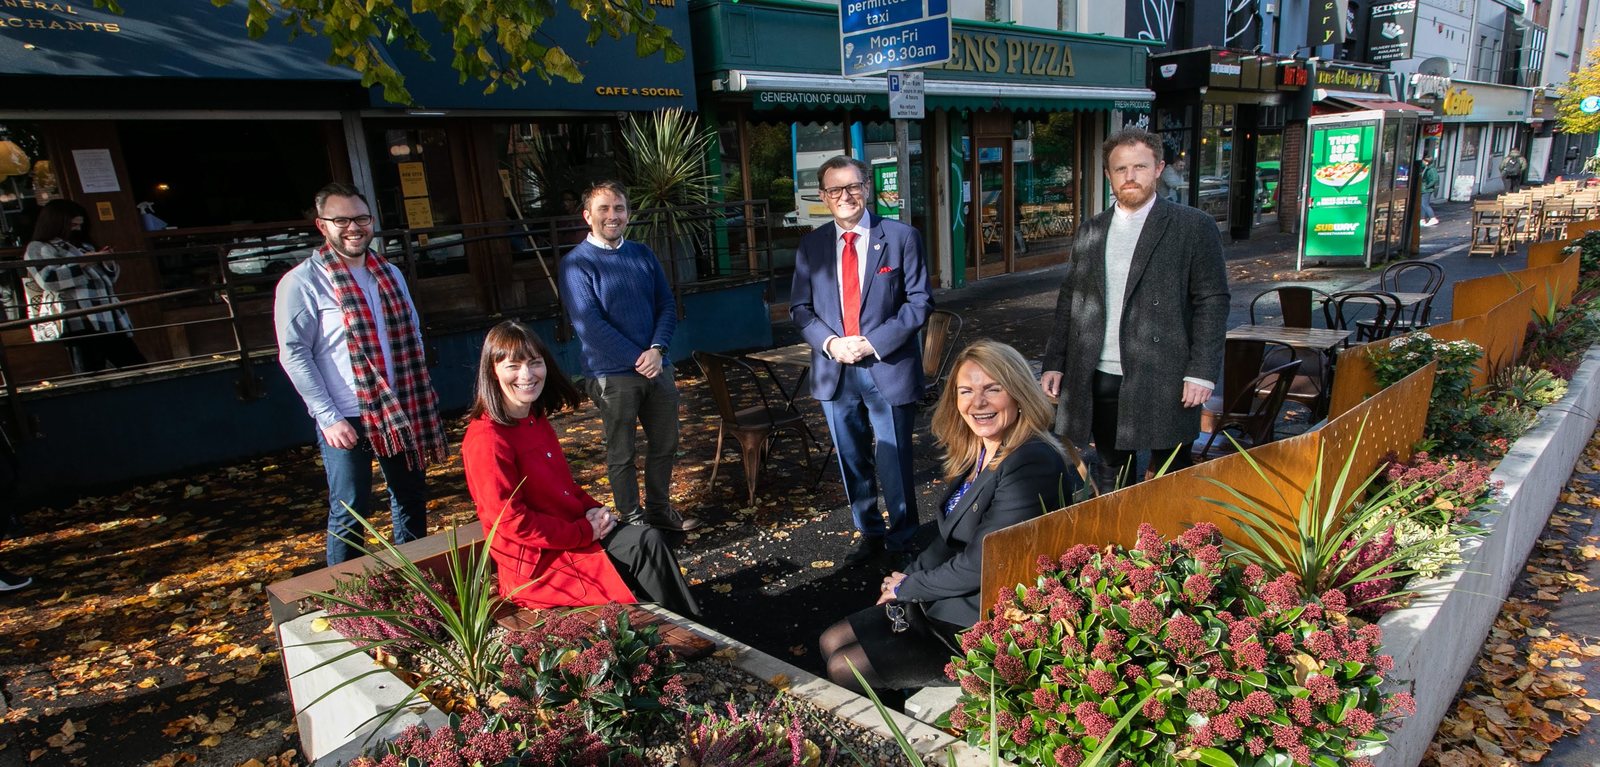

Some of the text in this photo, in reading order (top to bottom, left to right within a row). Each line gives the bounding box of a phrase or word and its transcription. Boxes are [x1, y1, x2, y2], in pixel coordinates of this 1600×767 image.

[0, 0, 78, 14] NERAL
[1372, 1, 1416, 15] KINGS
[866, 9, 889, 26] taxi
[870, 28, 918, 49] Mon-Fri
[854, 44, 936, 68] 7.30-9.30am
[1005, 39, 1075, 77] PIZZA
[595, 86, 629, 95] CAFE
[641, 88, 684, 96] SOCIAL
[760, 91, 867, 104] GENERATION OF QUALITY
[1114, 100, 1150, 109] FRESH PRODUCE
[1328, 135, 1359, 145] THIS
[1331, 144, 1357, 154] IS A
[1314, 223, 1360, 232] SUBWAY
